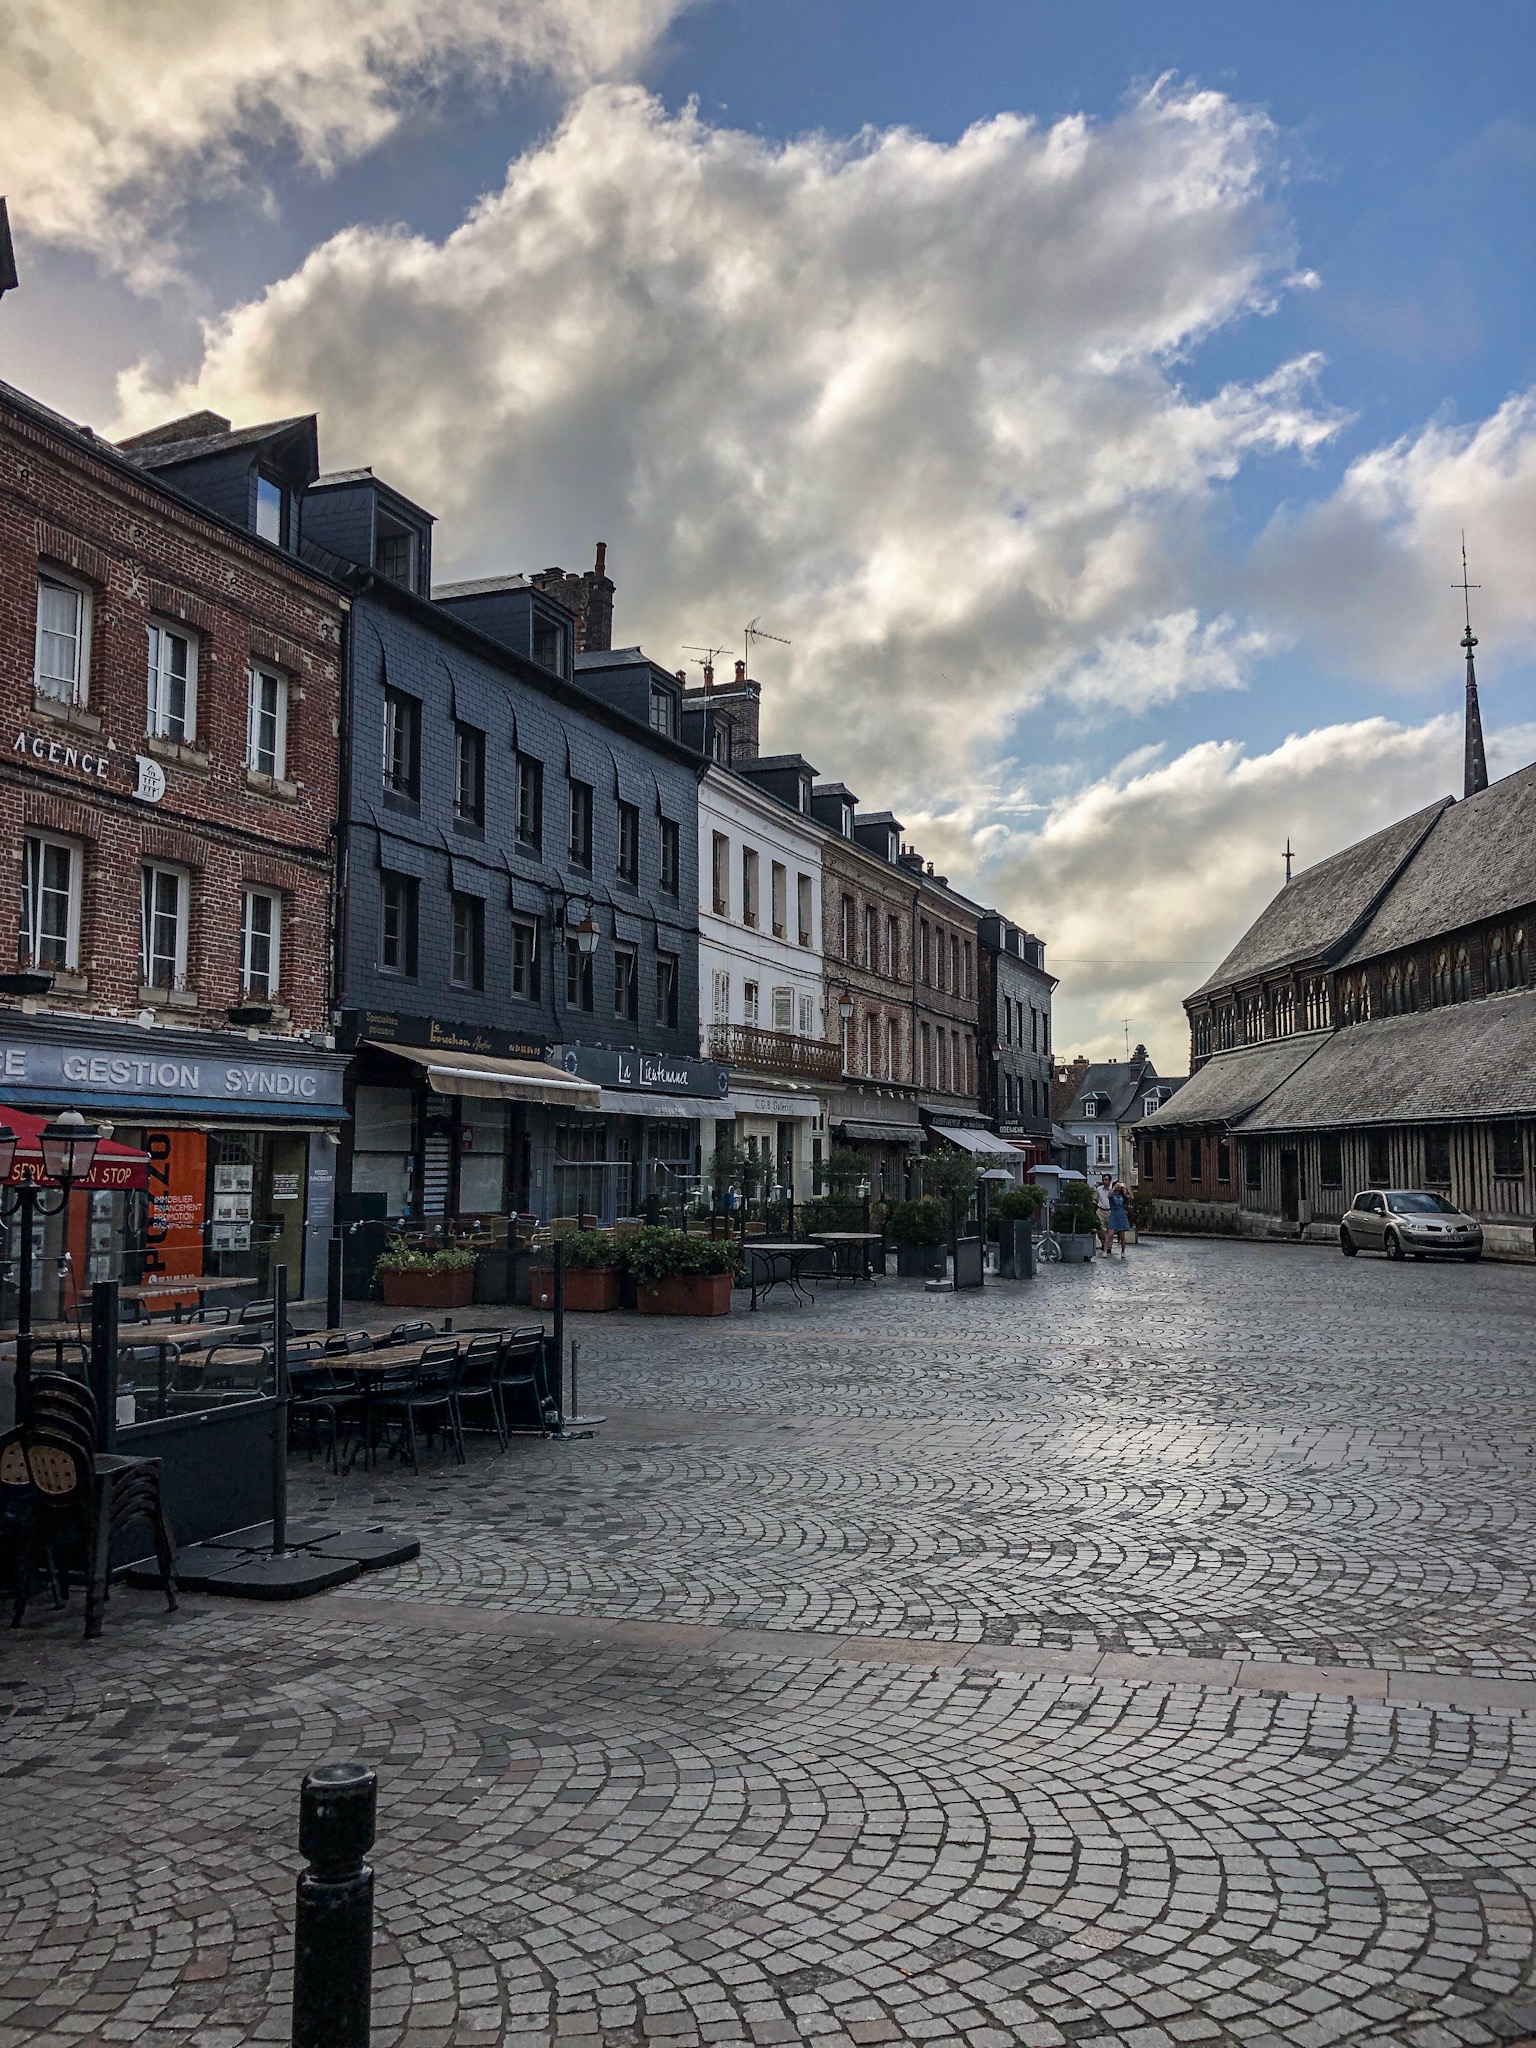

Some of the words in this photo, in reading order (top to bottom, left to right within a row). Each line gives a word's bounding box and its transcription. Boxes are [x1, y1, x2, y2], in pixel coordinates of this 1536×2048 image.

[13, 732, 109, 779] AGENCE
[430, 1031, 471, 1047] bouchon
[63, 1055, 200, 1089] GESTION
[225, 1068, 317, 1098] SYNDIC
[618, 1055, 632, 1084] La
[639, 1058, 689, 1086] Lieutenance
[101, 1167, 132, 1184] STOP
[154, 1195, 194, 1204] IMMOBILIER
[154, 1203, 202, 1212] FINANCEMENT
[153, 1212, 195, 1221] PROMOTION
